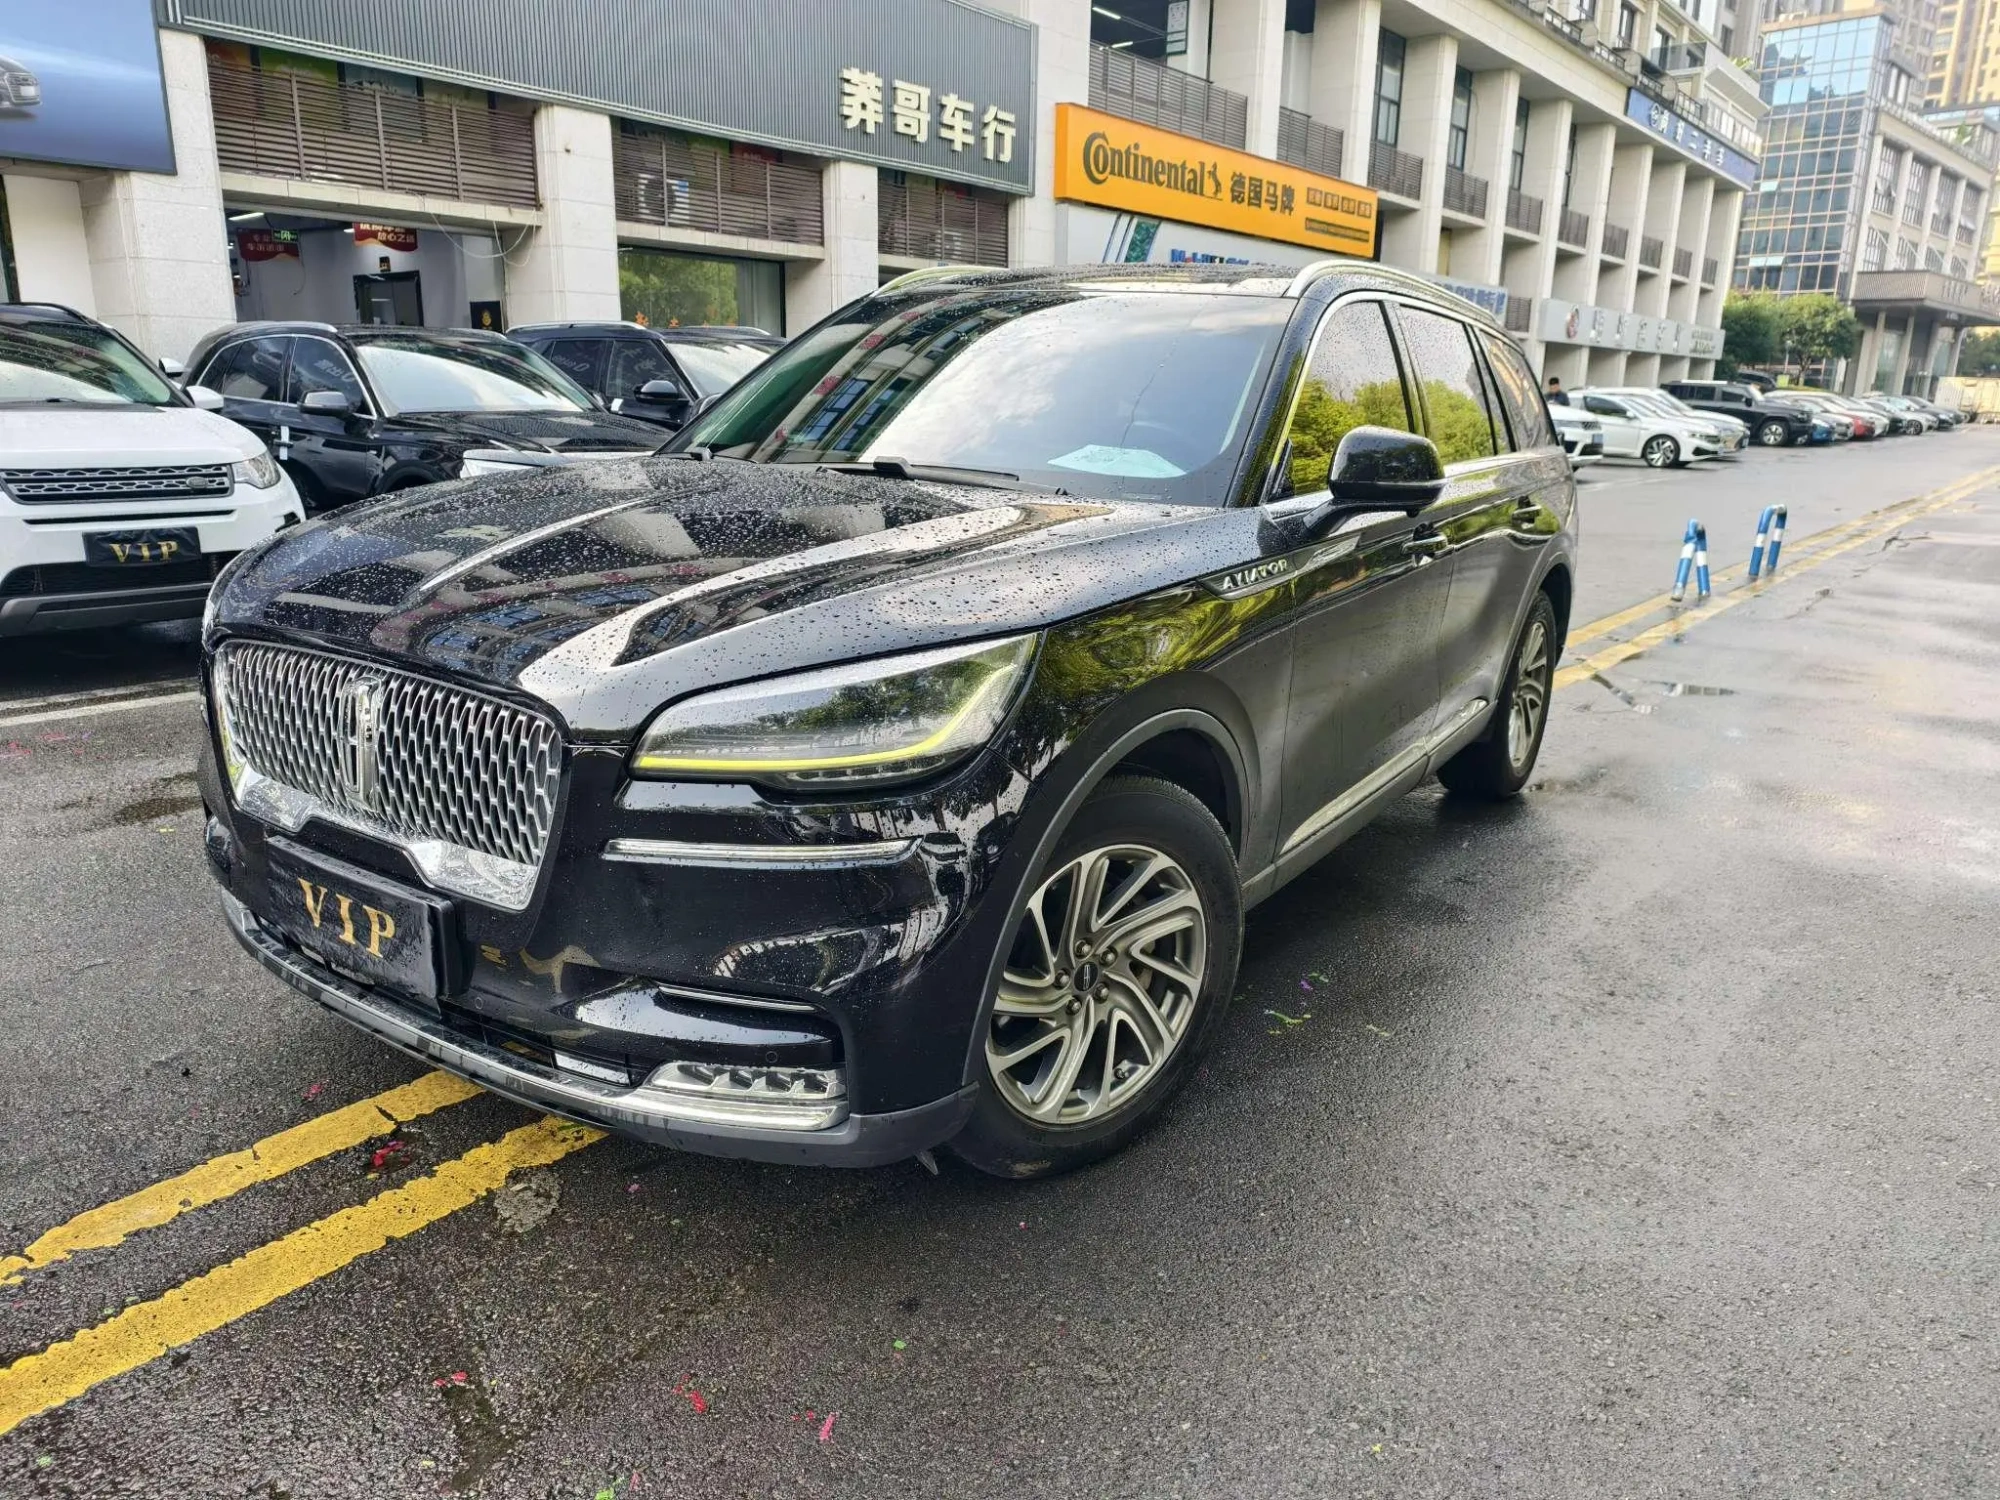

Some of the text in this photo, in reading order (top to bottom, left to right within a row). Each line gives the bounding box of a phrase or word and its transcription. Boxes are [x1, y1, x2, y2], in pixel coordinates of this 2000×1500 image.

[840, 66, 1017, 163] 莽哥车行
[1083, 131, 1205, 197] Continental
[1230, 171, 1295, 216] 德国马牌
[109, 540, 179, 564] VIP
[1222, 559, 1288, 590] AVIATOR
[297, 876, 397, 959] VIP
